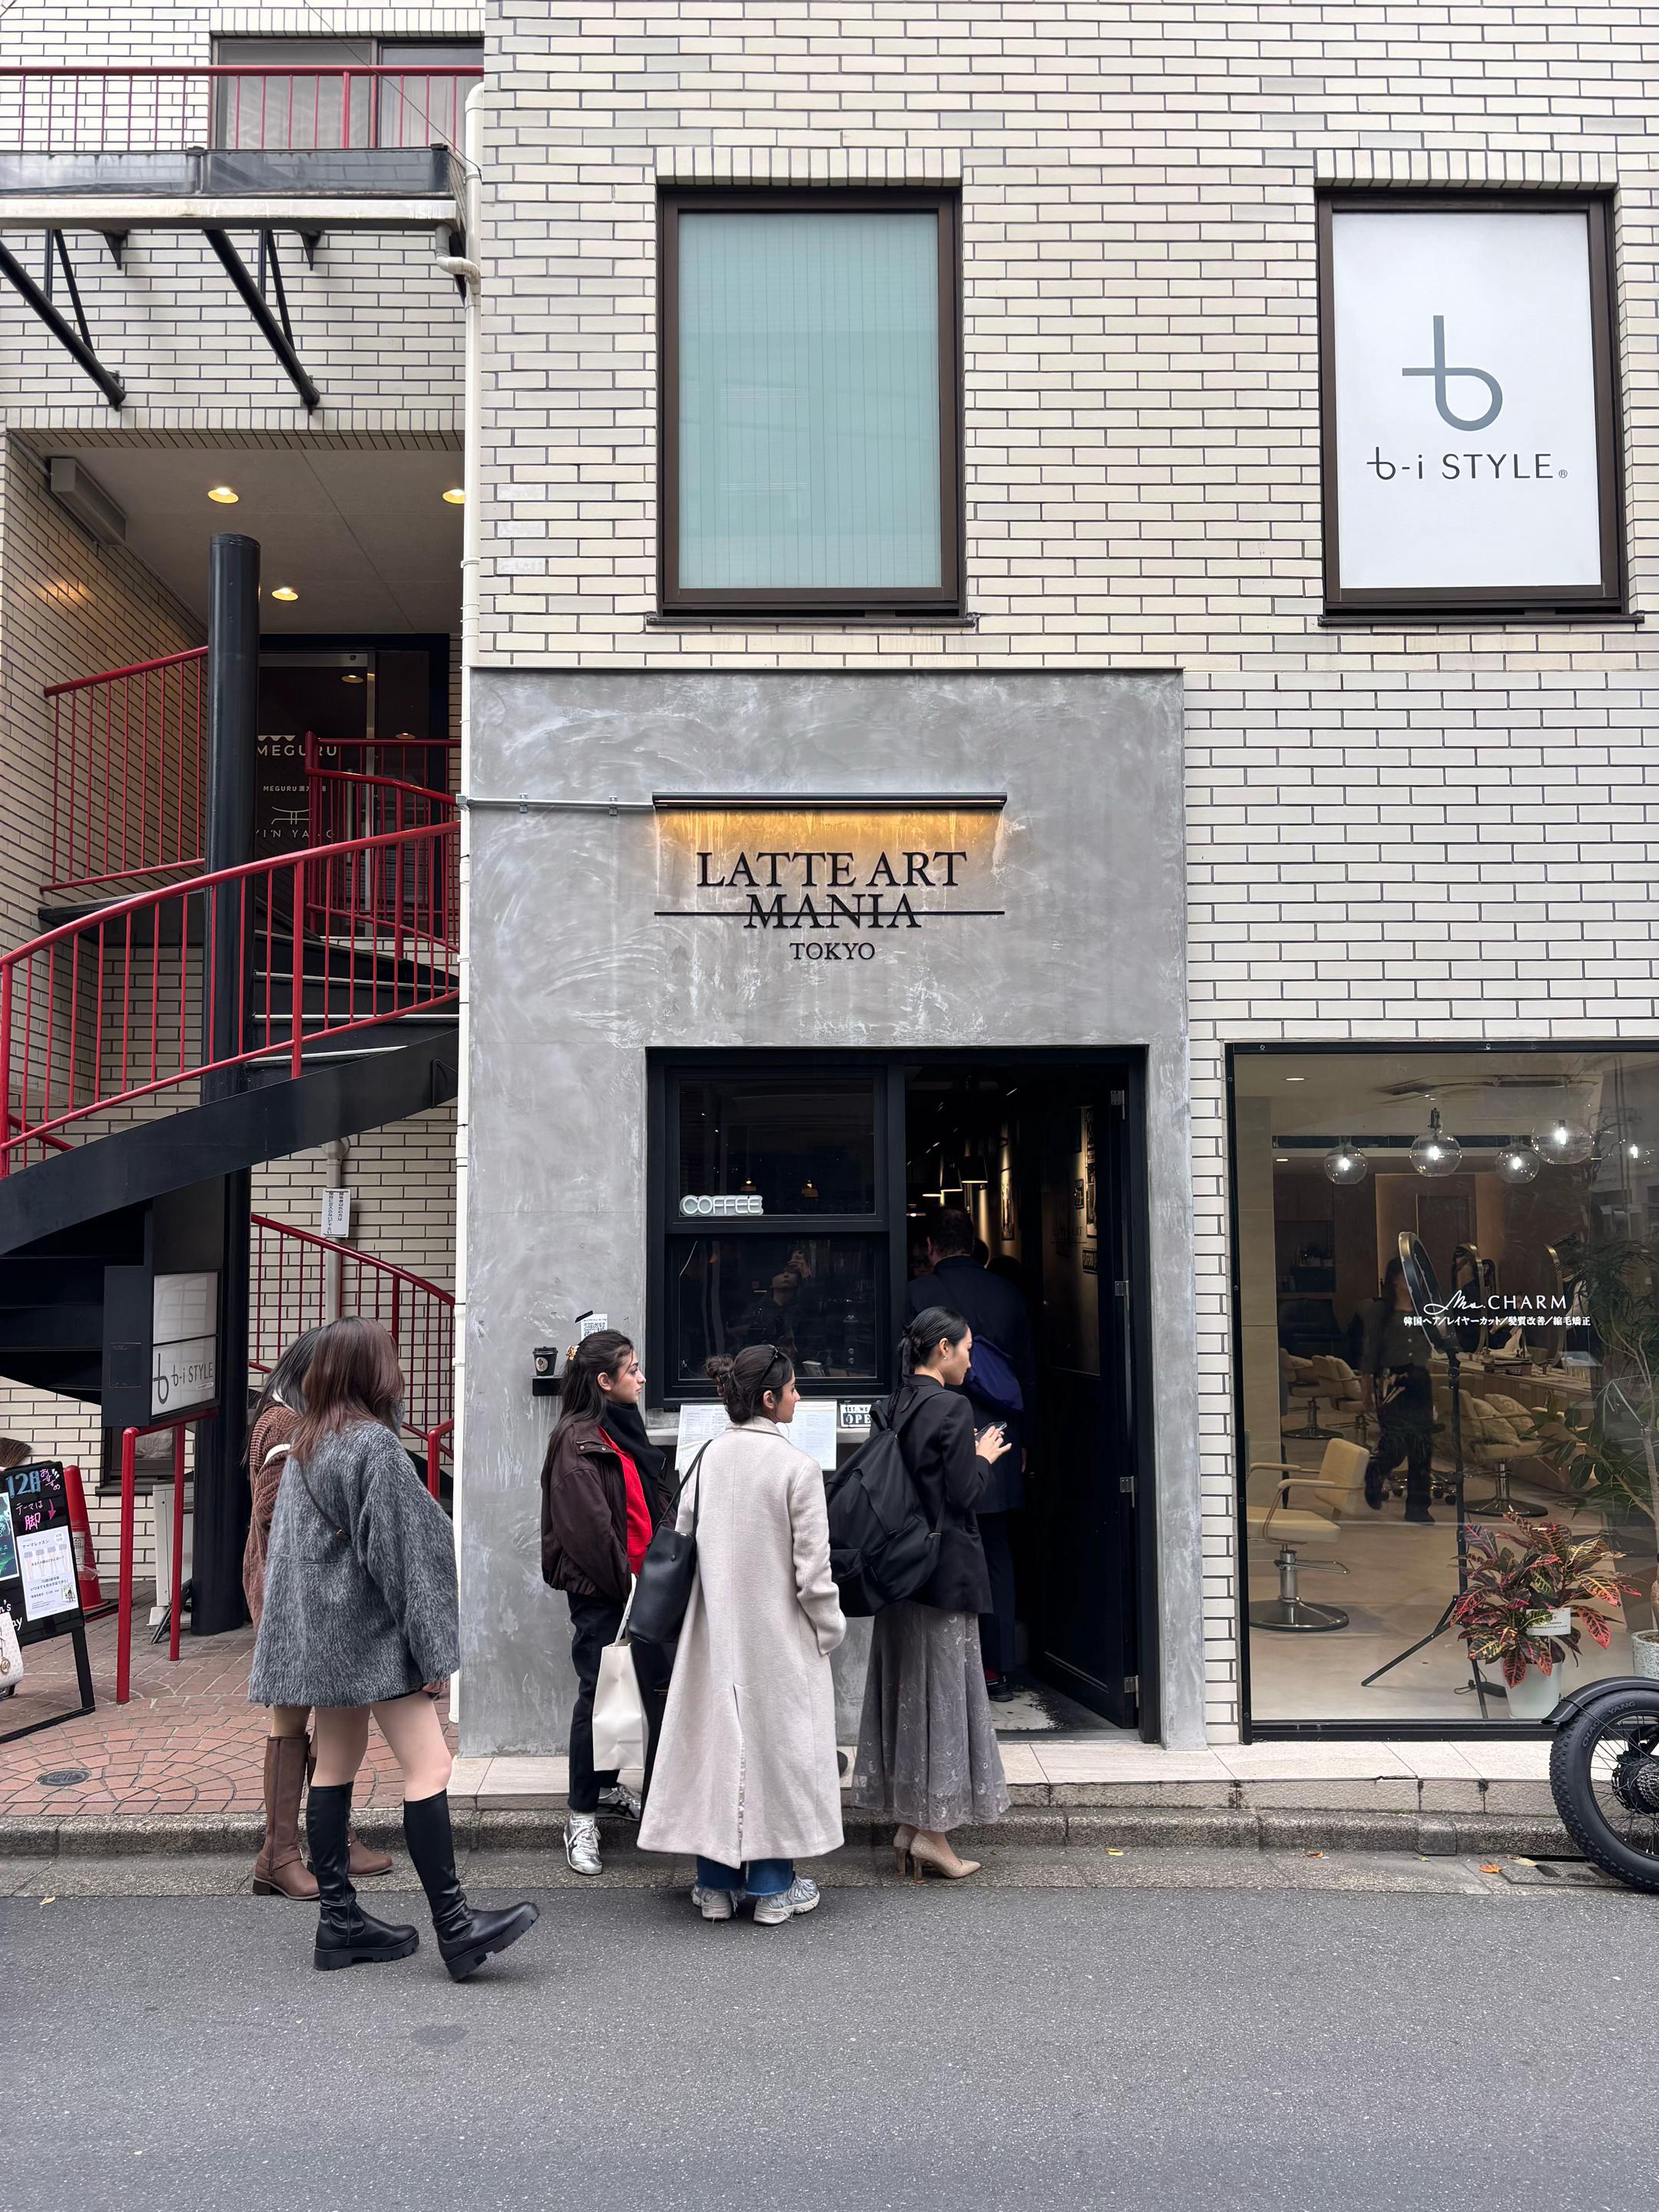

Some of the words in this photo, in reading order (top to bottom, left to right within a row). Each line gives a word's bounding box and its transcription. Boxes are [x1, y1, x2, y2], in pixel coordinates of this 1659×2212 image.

[292, 830, 333, 839] YAG
[696, 852, 856, 887] LATTE
[866, 852, 968, 887] ART
[743, 893, 922, 929] MANIA
[789, 942, 876, 960] TOKYO
[682, 1196, 762, 1214] COFFEE
[1488, 1295, 1567, 1310] CHARM
[188, 1362, 214, 1383] STYLE
[6, 1471, 41, 1498] 12月
[15, 1500, 44, 1516] テーマは
[25, 1512, 41, 1532] 脚
[1608, 1700, 1637, 1715] YANG
